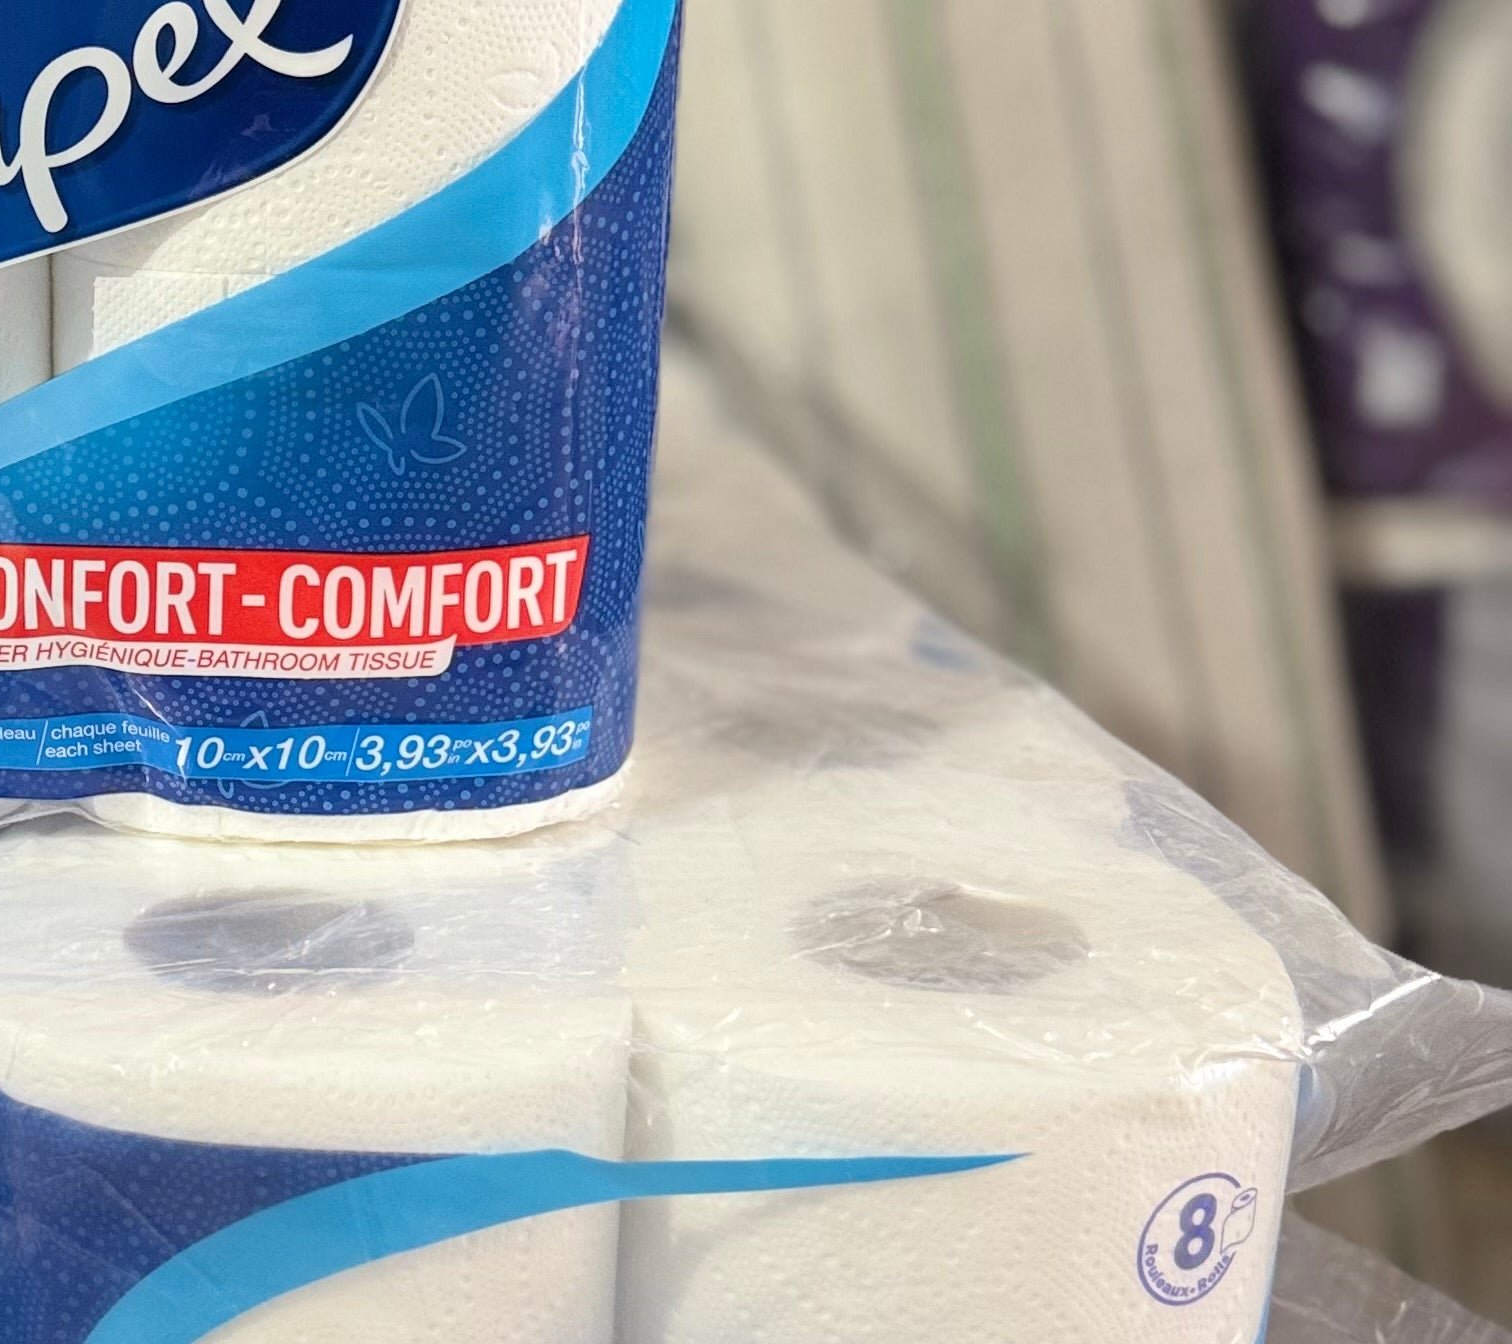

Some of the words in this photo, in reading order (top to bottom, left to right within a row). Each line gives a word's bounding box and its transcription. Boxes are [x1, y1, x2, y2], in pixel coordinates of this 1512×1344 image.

[348, 648, 437, 671] TISSUE
[50, 721, 117, 742] chaque
[121, 720, 170, 744] feuille
[44, 742, 89, 759] each
[92, 739, 142, 755] sheet
[1173, 1193, 1218, 1271] 8
